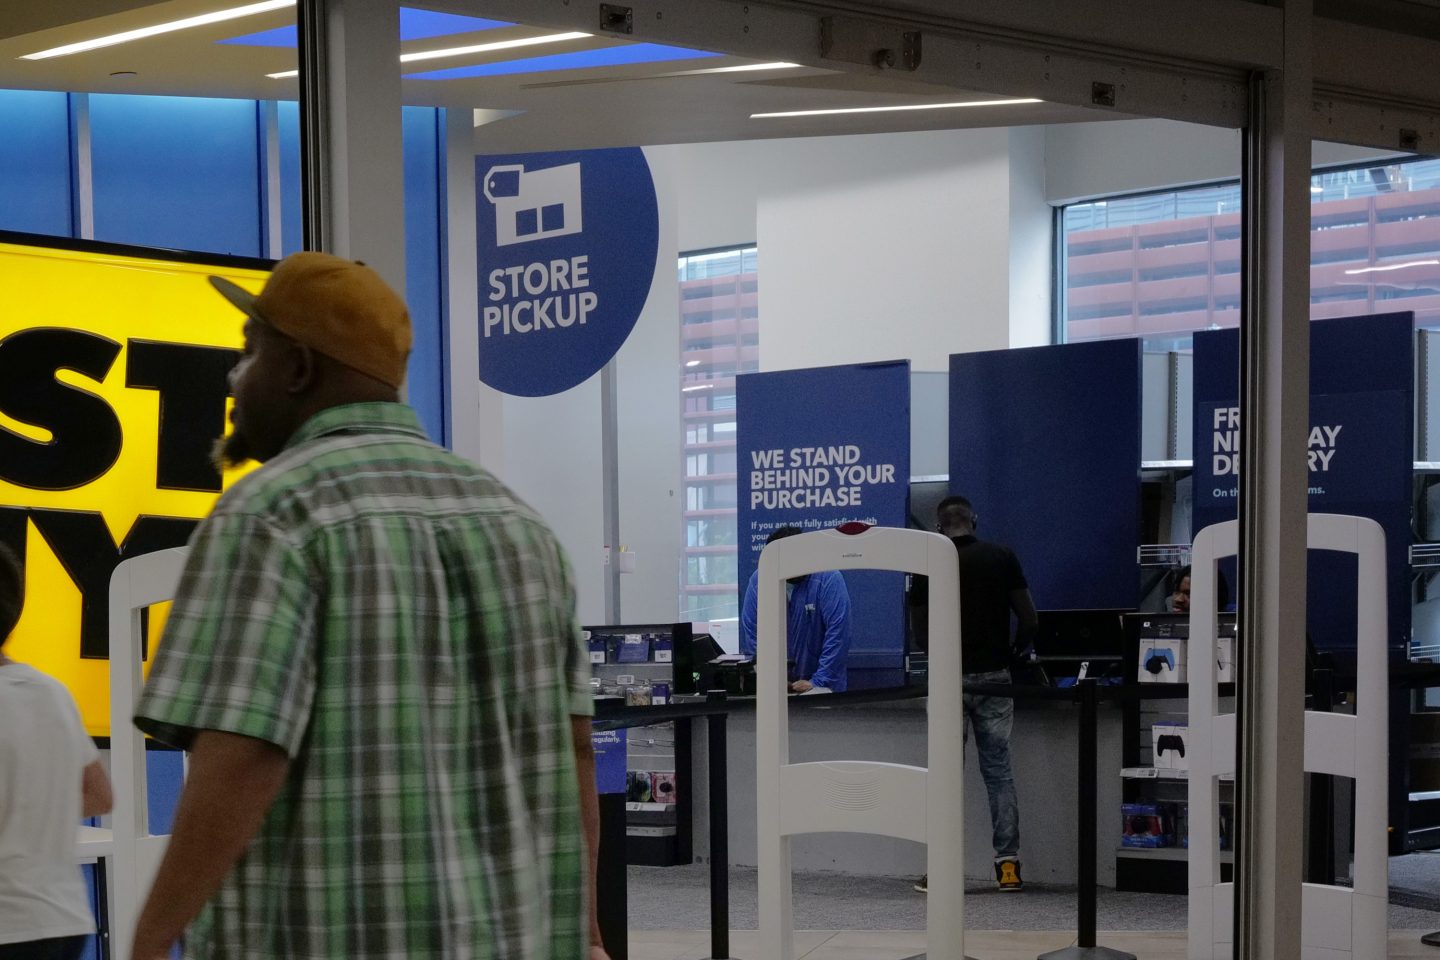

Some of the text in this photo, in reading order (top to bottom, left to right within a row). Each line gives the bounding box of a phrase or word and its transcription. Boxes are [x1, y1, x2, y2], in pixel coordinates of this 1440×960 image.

[488, 254, 590, 301] STORE
[483, 291, 598, 338] PICKUP
[751, 445, 861, 469] WE STAND
[751, 464, 896, 490] BEHIND YOUR
[751, 487, 862, 510] PURCHASE
[1212, 488, 1228, 498] On
[751, 521, 758, 529] If
[758, 521, 773, 531] you
[804, 519, 823, 530] fully
[751, 534, 769, 544] your
